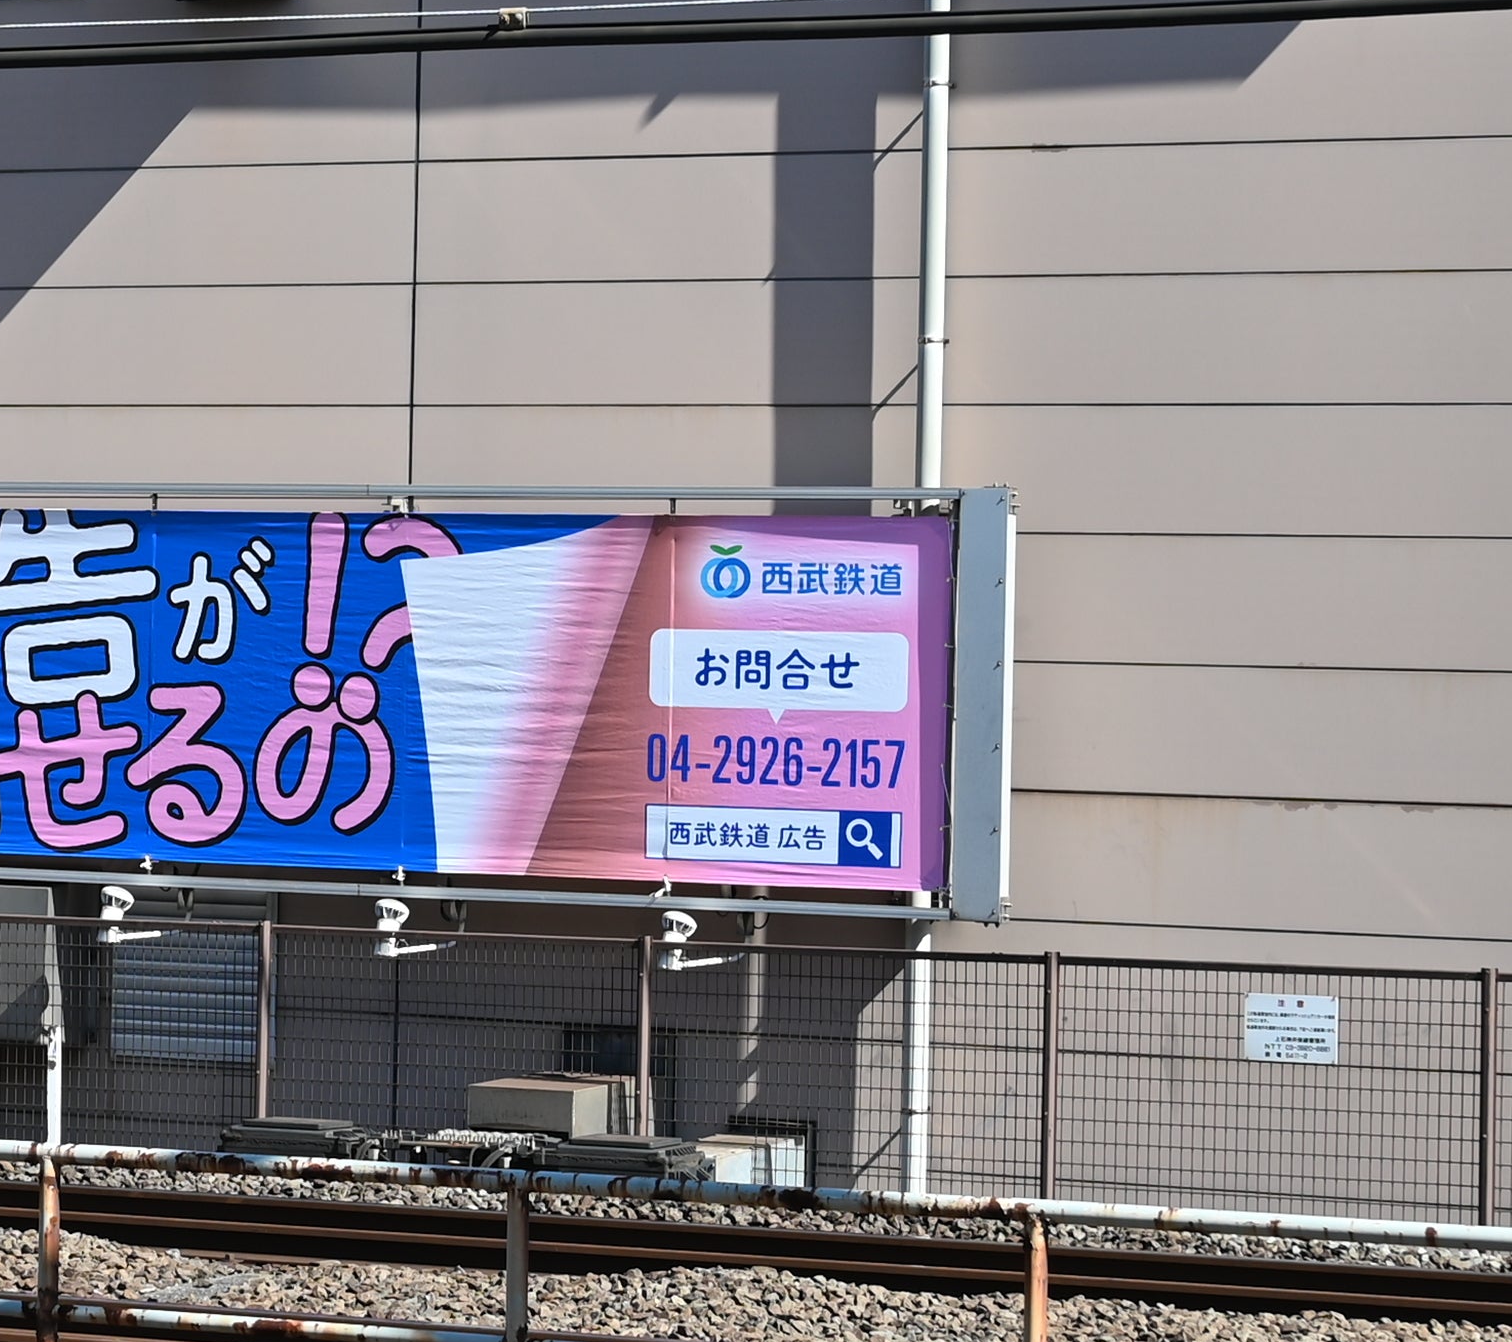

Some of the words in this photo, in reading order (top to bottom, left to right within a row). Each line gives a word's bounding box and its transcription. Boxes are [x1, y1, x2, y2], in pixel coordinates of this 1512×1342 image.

[761, 562, 903, 596] 西武鉄道
[694, 648, 860, 690] お問合せ
[646, 733, 906, 789] 04-2926-2157
[668, 821, 771, 848] 西武鉄道
[776, 825, 826, 851] 広告
